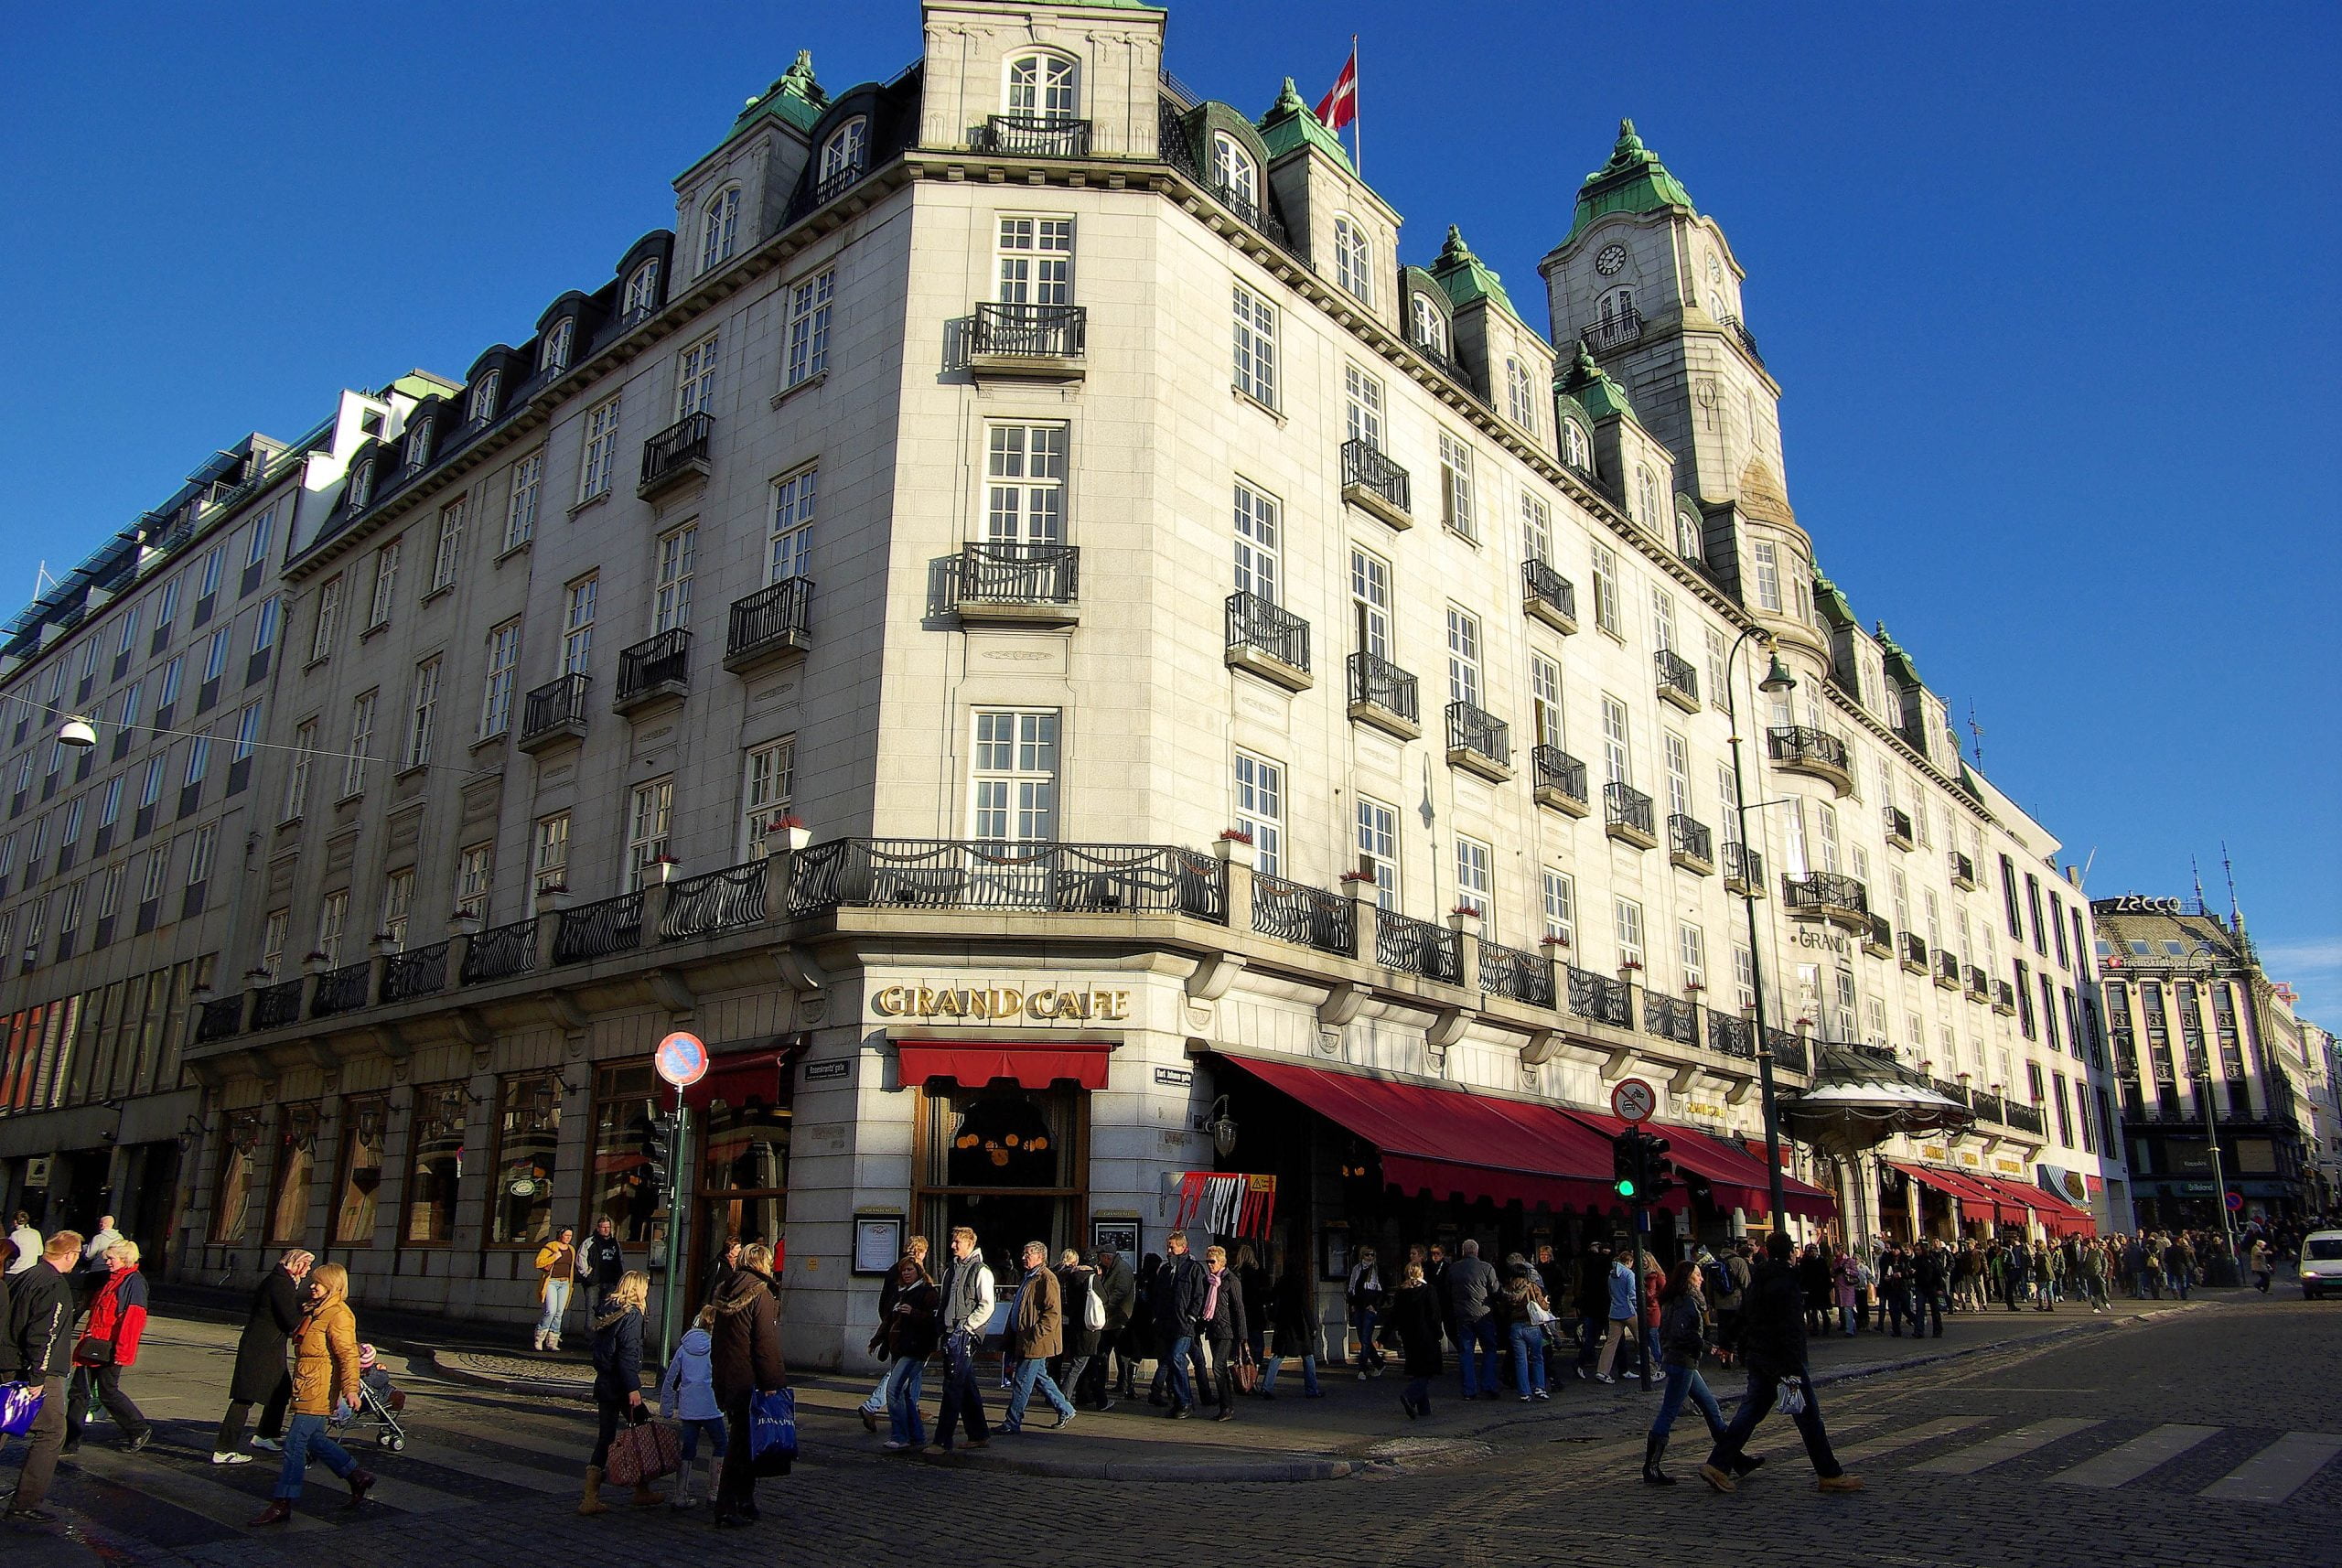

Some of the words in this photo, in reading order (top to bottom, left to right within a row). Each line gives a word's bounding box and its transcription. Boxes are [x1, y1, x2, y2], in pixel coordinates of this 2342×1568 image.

[1799, 931, 1844, 953] GRAND
[878, 985, 1024, 1017] GRAND
[1034, 988, 1131, 1019] CAFE
